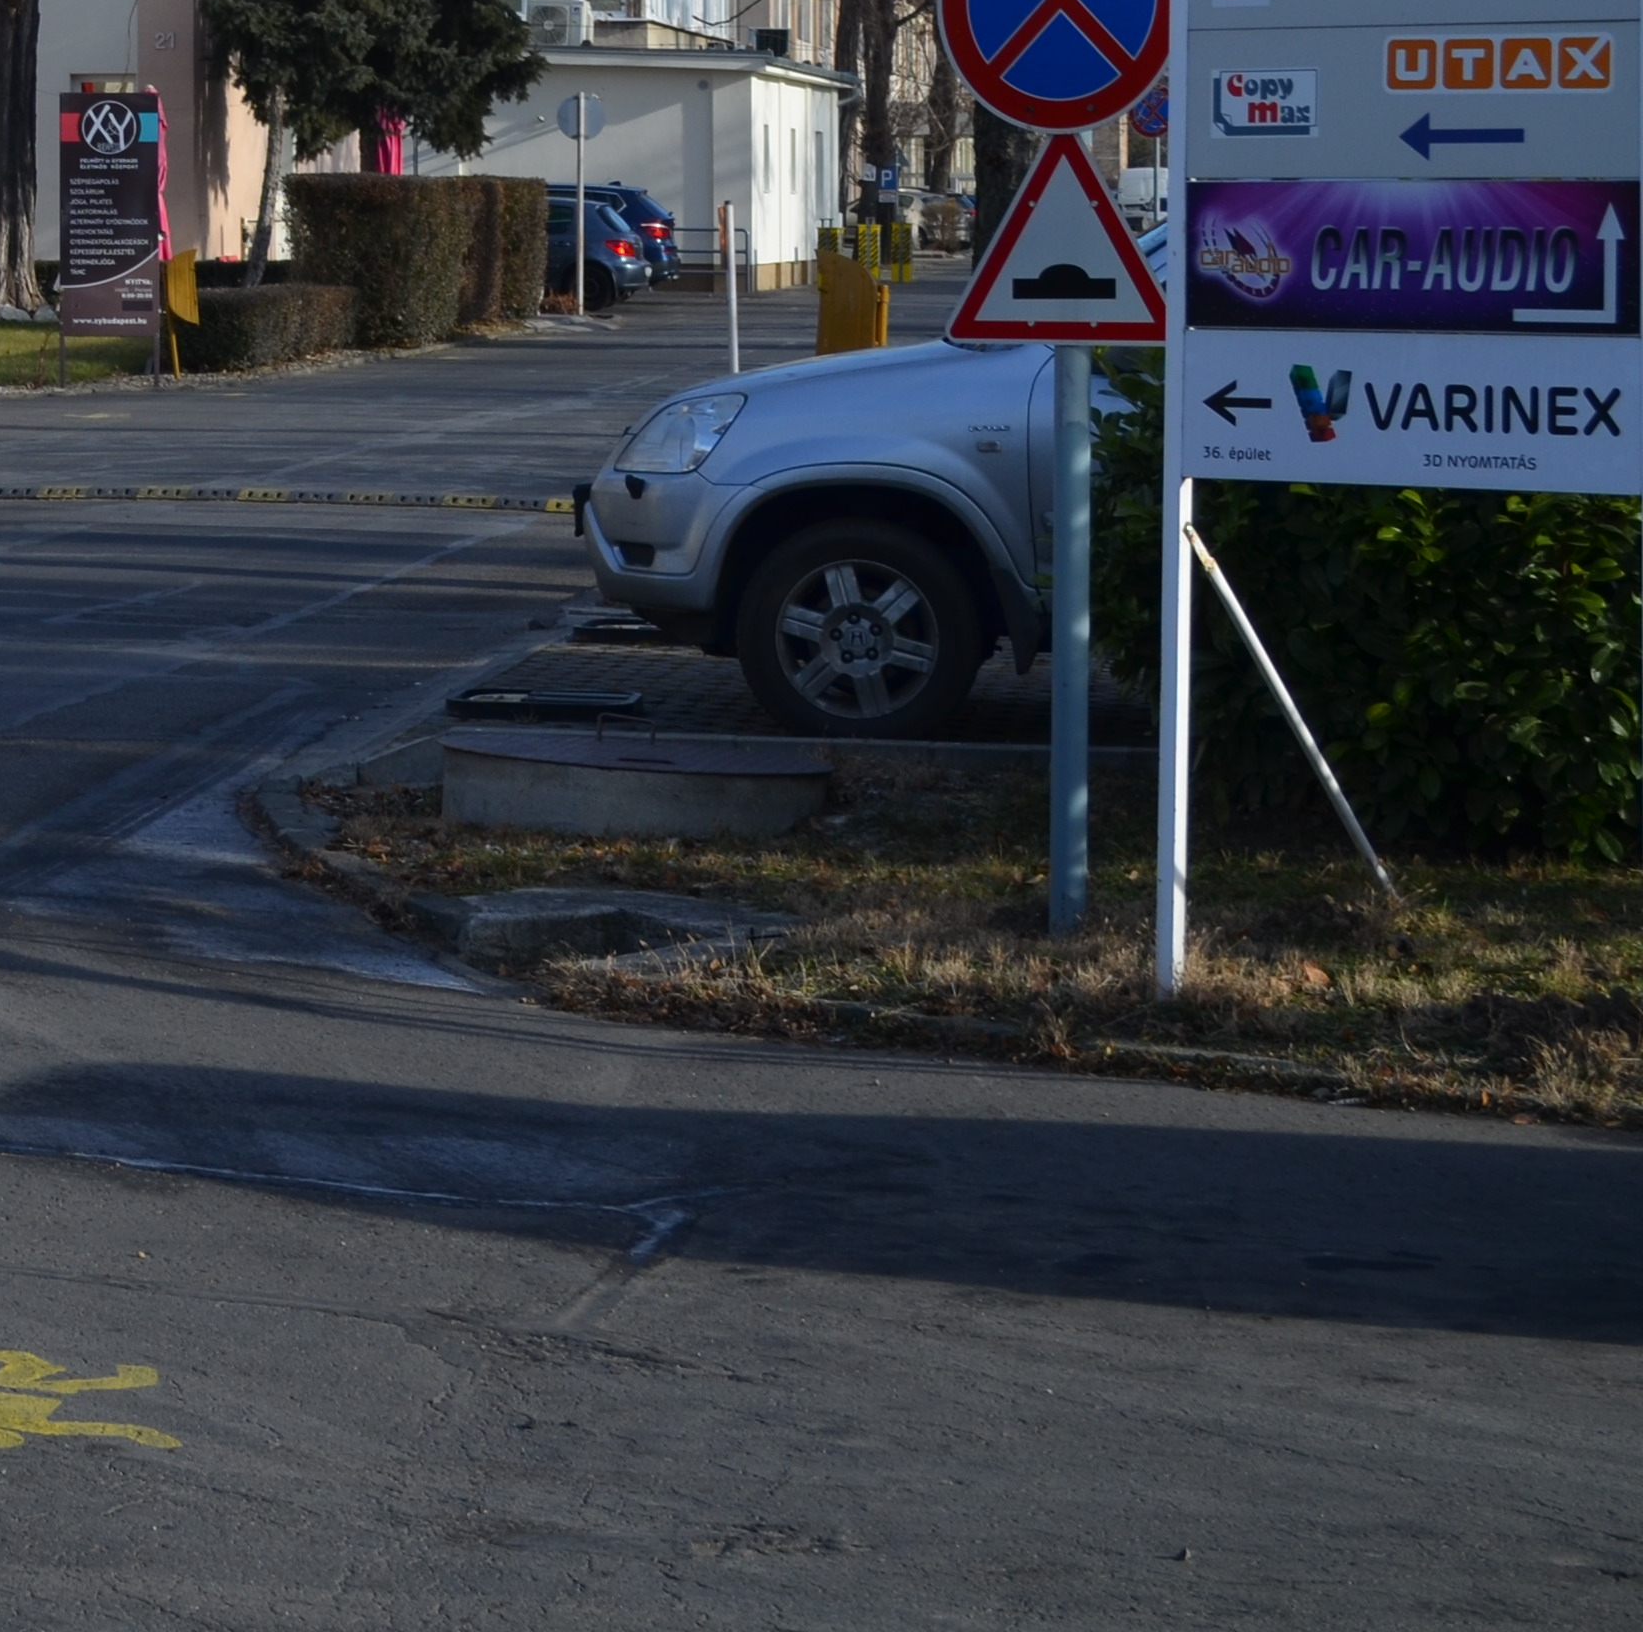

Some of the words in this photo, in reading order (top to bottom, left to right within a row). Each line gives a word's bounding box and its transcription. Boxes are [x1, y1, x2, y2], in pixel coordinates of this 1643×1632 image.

[155, 31, 175, 50] 21
[1390, 41, 1610, 87] UTAX
[1226, 73, 1294, 100] Copy
[1310, 224, 1580, 294] CAR-AUDIO
[1364, 382, 1622, 437] VARINEX
[1202, 445, 1225, 460] 36.
[1228, 446, 1273, 464] épület
[1422, 453, 1443, 469] 3D
[1447, 453, 1537, 471] NYOMTATÁS
